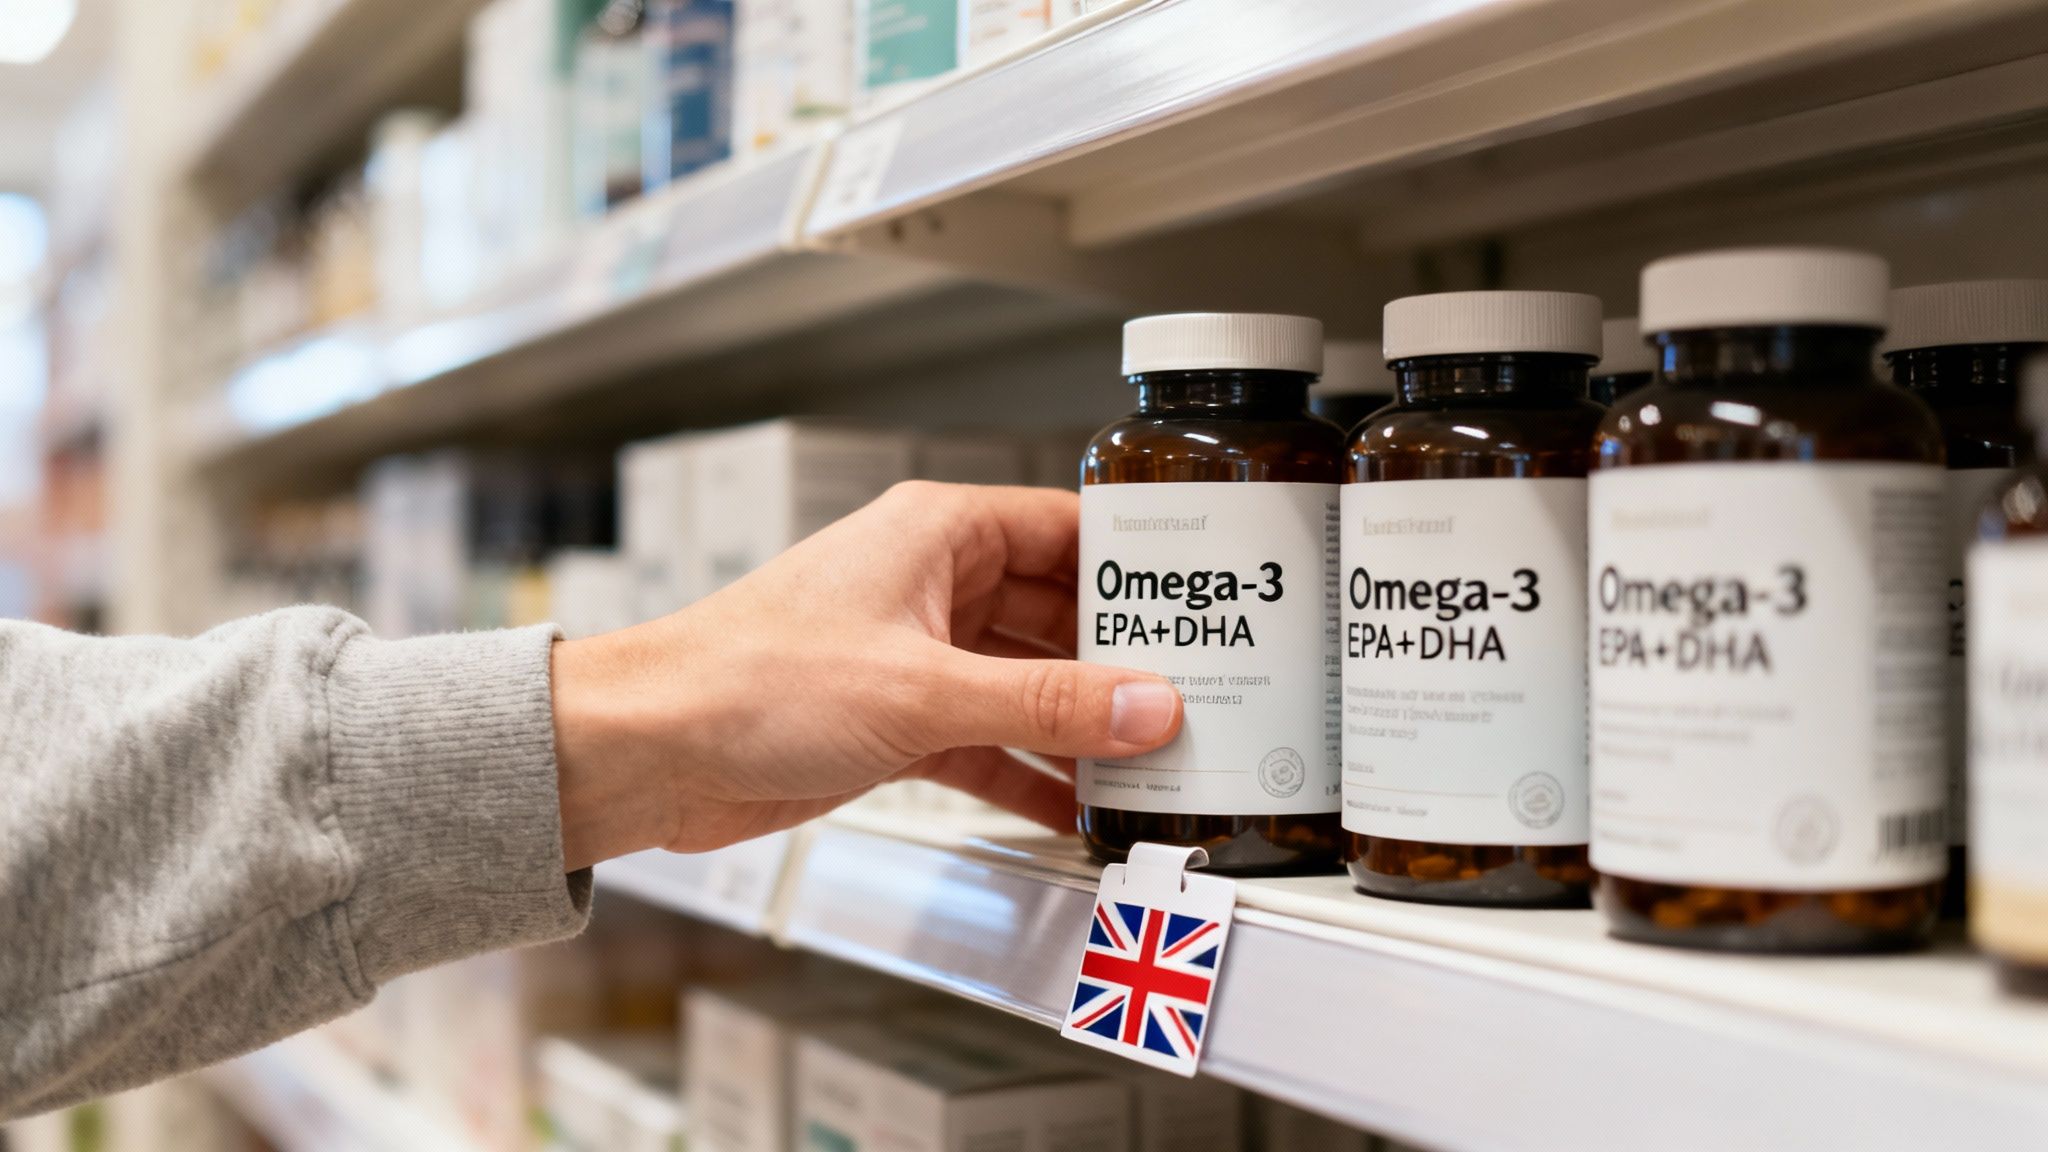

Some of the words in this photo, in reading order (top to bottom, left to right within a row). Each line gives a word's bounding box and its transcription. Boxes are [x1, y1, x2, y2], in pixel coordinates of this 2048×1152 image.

[1097, 560, 1283, 610] Omega-3
[1349, 567, 1541, 622] Omega-3
[1599, 563, 1808, 625] Omega-3
[1095, 612, 1255, 647] EPA+DHA
[1348, 622, 1506, 661] EPA+DHA
[1599, 627, 1773, 673] EPA+DHA
